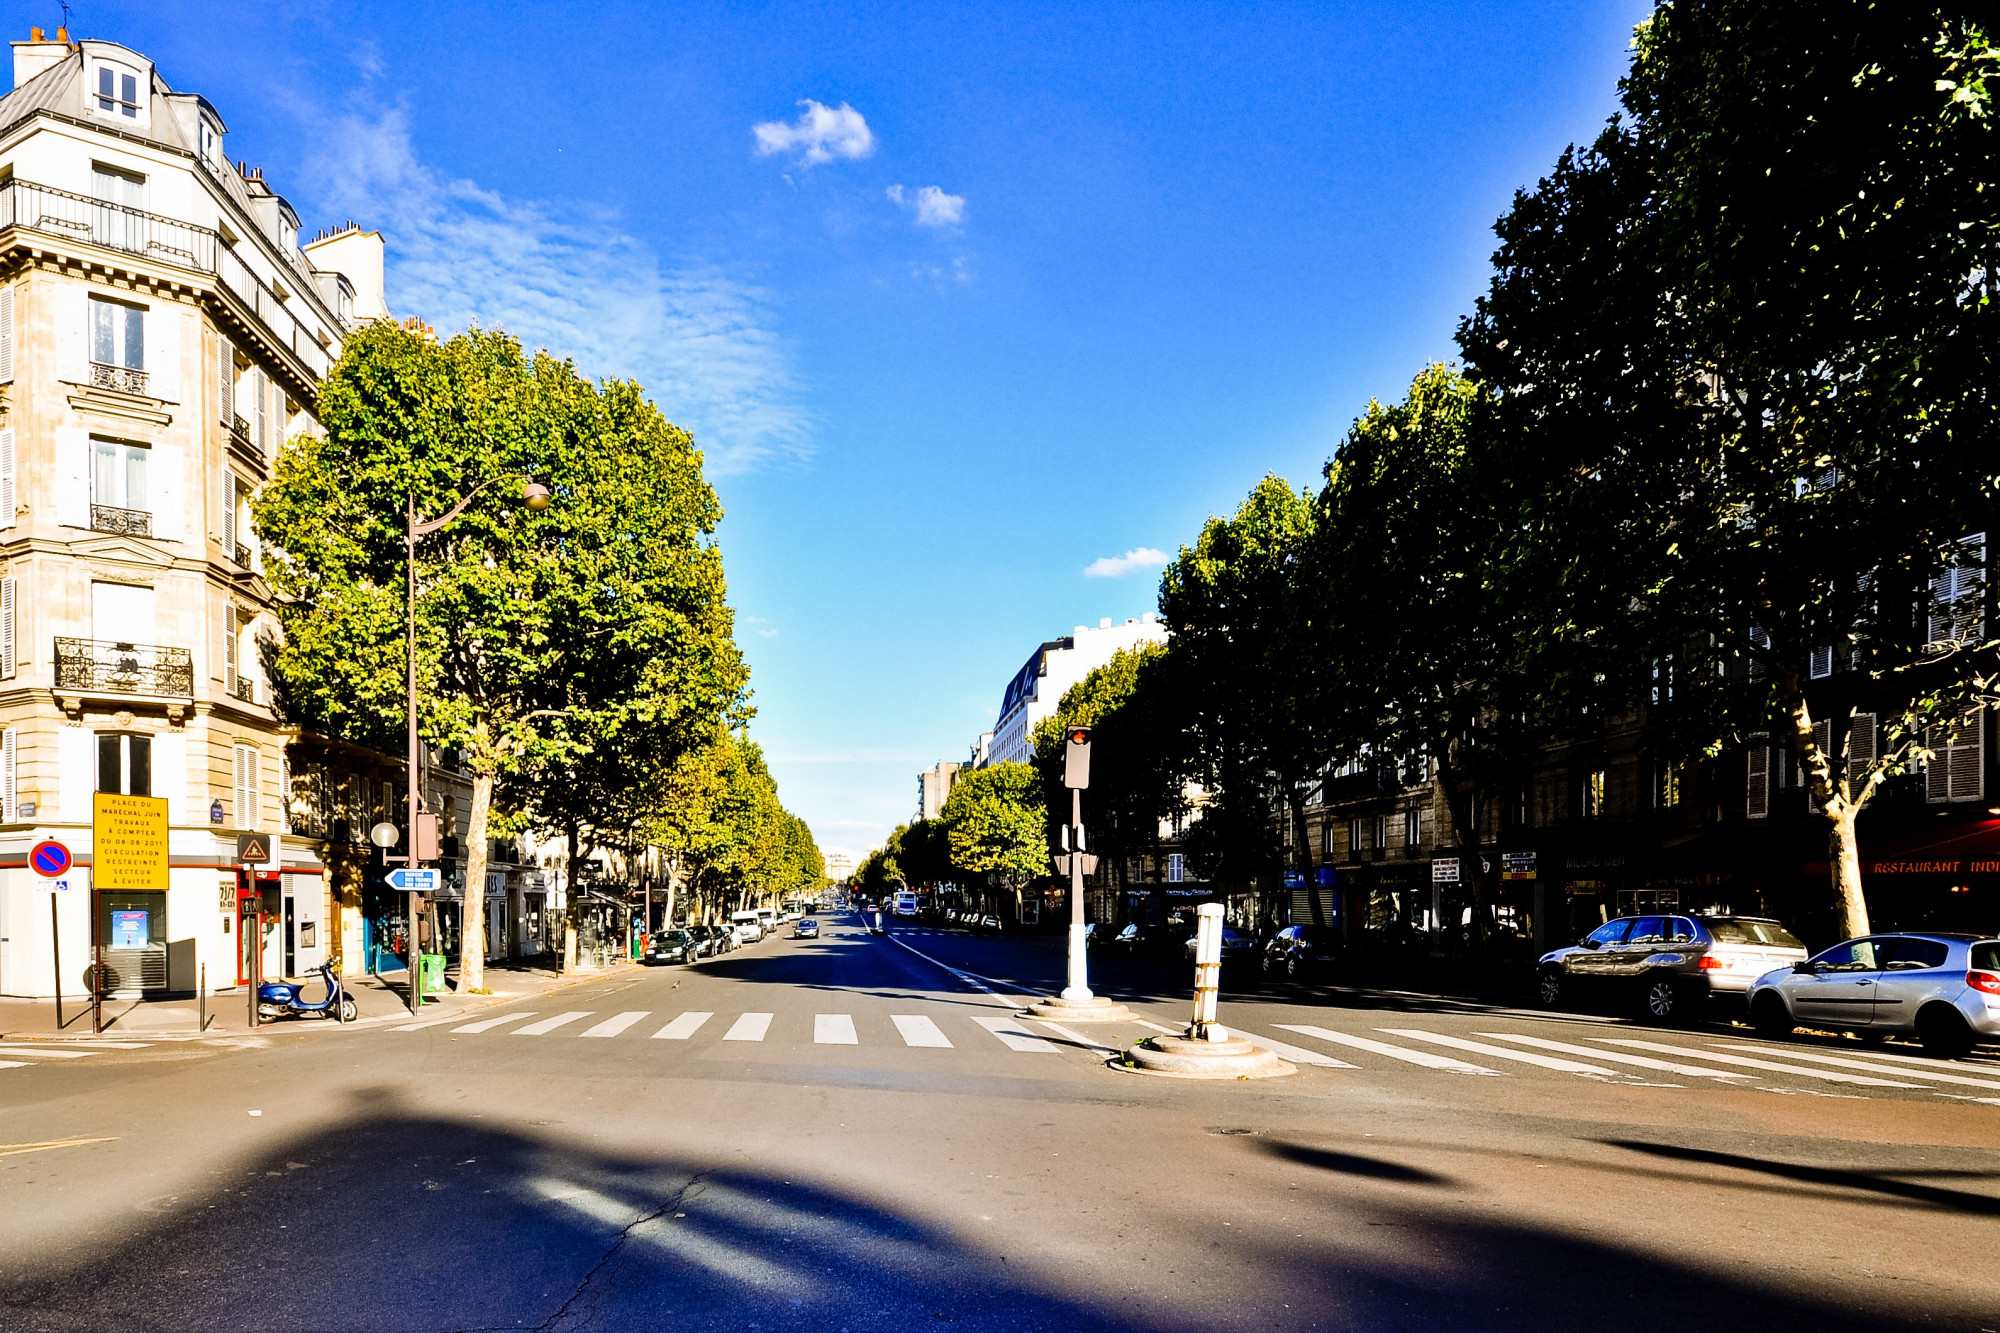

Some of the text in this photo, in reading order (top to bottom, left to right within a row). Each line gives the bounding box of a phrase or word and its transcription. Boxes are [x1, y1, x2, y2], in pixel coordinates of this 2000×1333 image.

[102, 809, 141, 817] MARÉCHAL
[104, 848, 159, 856] CIRCULATION
[106, 858, 157, 866] RESTREINTE
[1874, 861, 1960, 873] RESTAURANT
